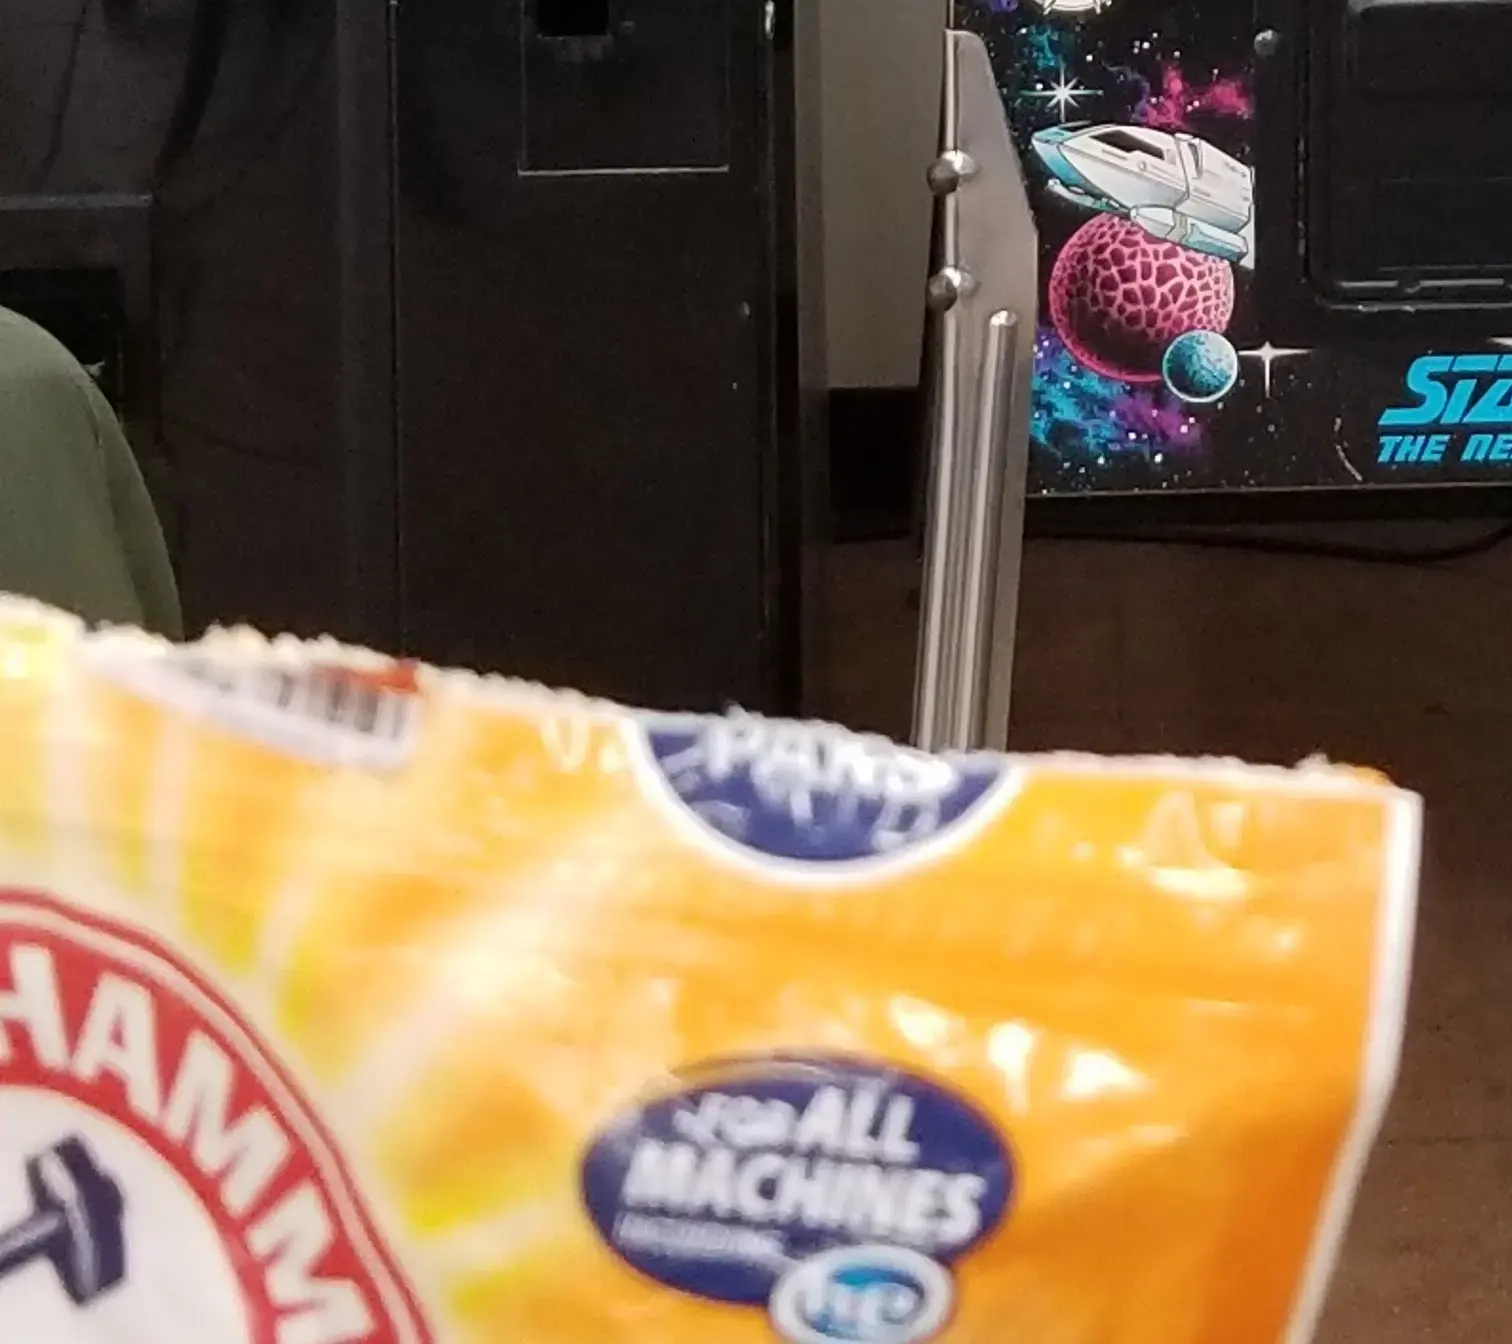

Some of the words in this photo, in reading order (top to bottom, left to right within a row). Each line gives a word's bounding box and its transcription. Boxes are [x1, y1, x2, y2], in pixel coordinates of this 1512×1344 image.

[1377, 432, 1452, 463] THE
[795, 1080, 921, 1164] ALL
[622, 1138, 988, 1248] MACHINES
